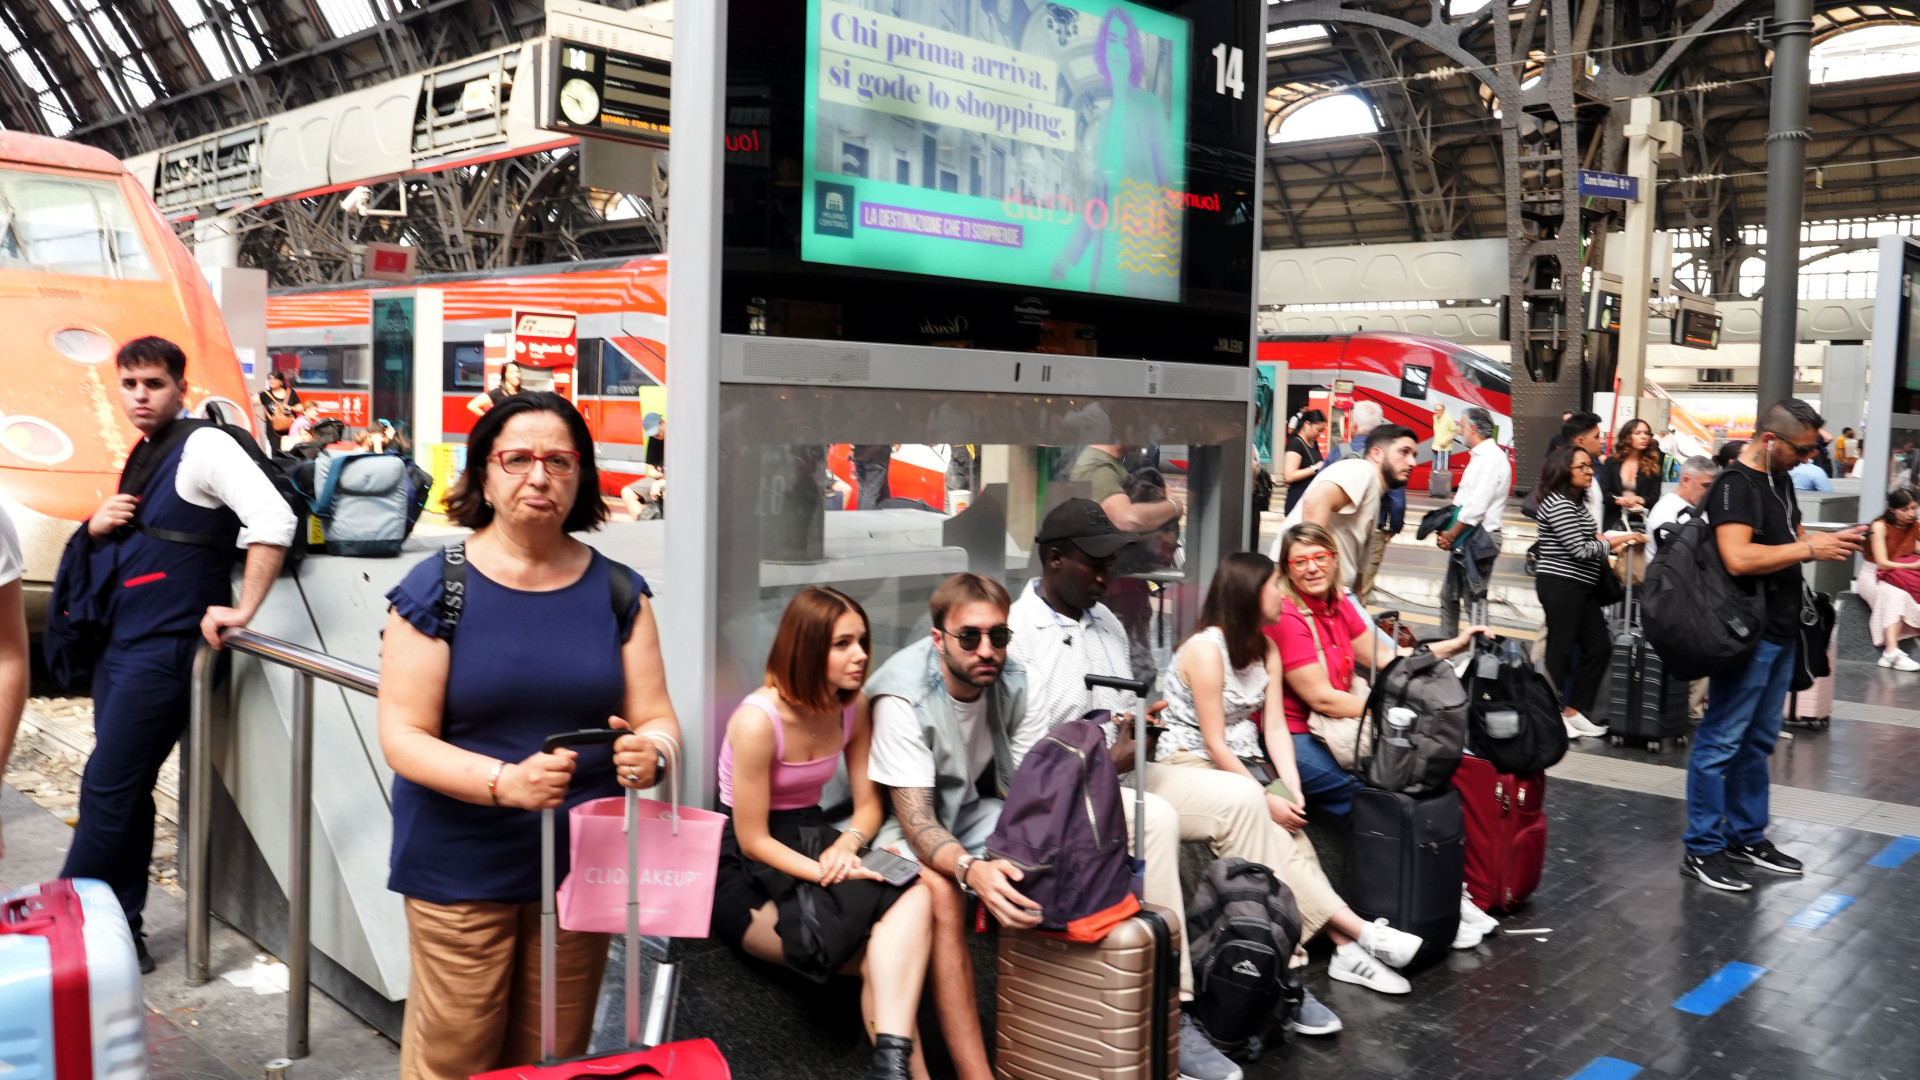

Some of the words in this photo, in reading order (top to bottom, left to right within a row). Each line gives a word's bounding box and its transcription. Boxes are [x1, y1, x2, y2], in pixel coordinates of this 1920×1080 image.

[831, 12, 878, 49] Chi
[886, 30, 965, 71] prima
[971, 55, 1048, 91] arriva.
[1211, 42, 1245, 100] 14
[828, 58, 850, 90] si
[856, 71, 921, 104] gode
[928, 80, 950, 110] lo
[955, 89, 1066, 143] shopping.
[864, 206, 878, 225] LA
[878, 208, 943, 235] DESTINAZIONE
[943, 218, 962, 237] CHE
[585, 867, 697, 888] CLIOAKEUP
